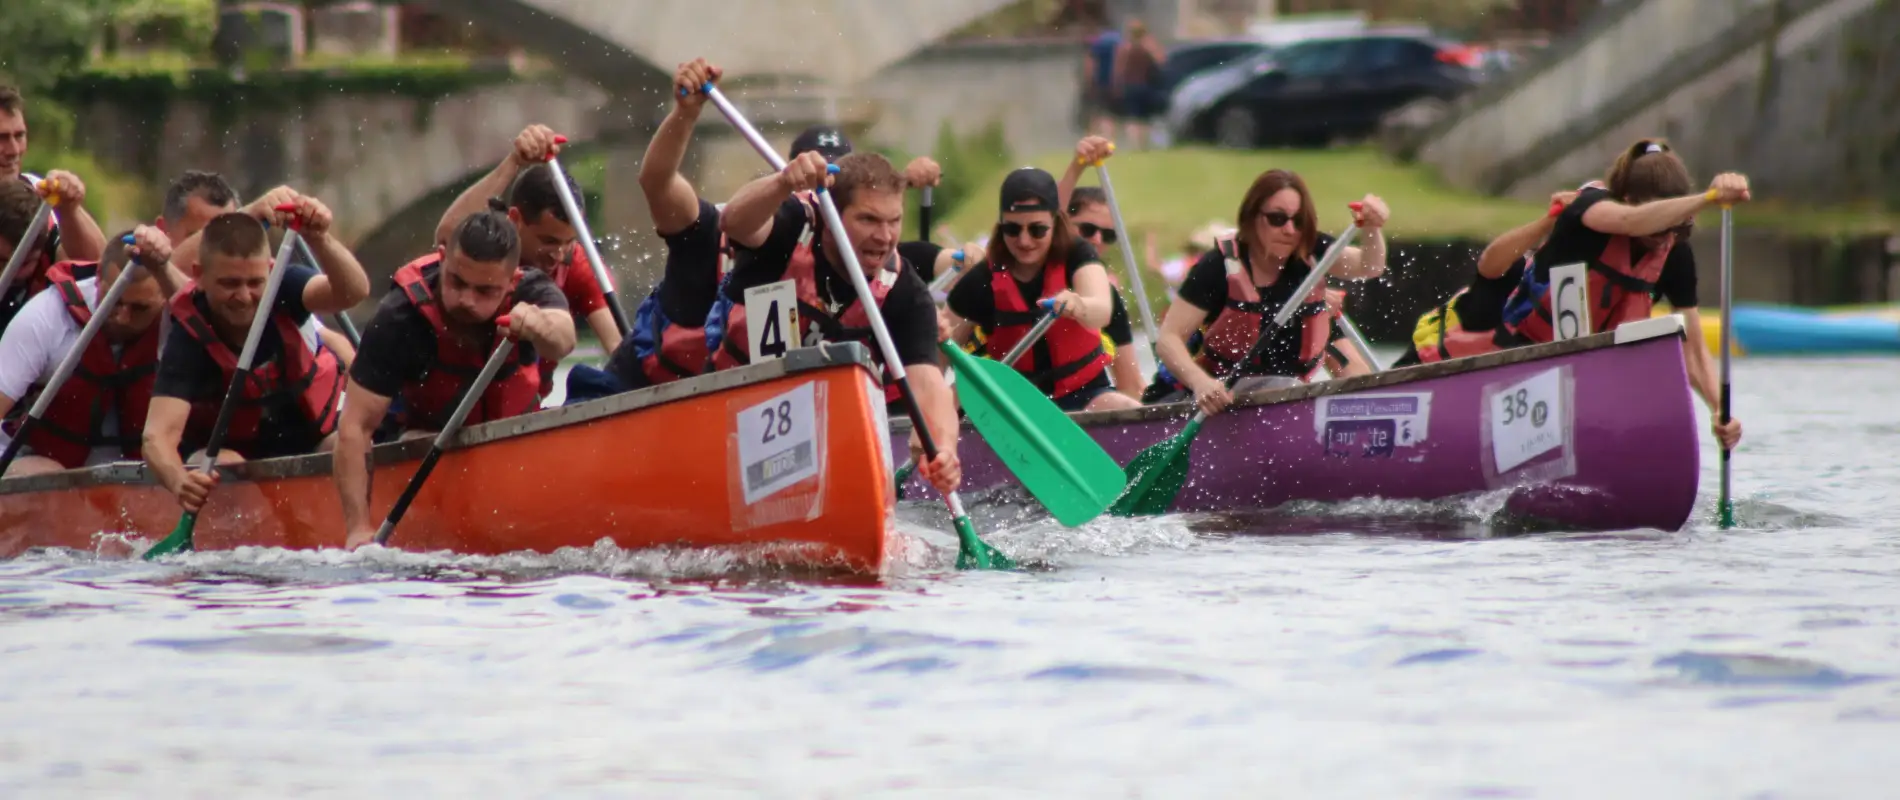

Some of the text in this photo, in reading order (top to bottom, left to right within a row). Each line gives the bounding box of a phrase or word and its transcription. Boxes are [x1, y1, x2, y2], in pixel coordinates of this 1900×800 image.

[760, 299, 786, 358] 4
[1557, 276, 1579, 340] 6
[761, 400, 792, 444] 28
[1502, 388, 1528, 426] 38
